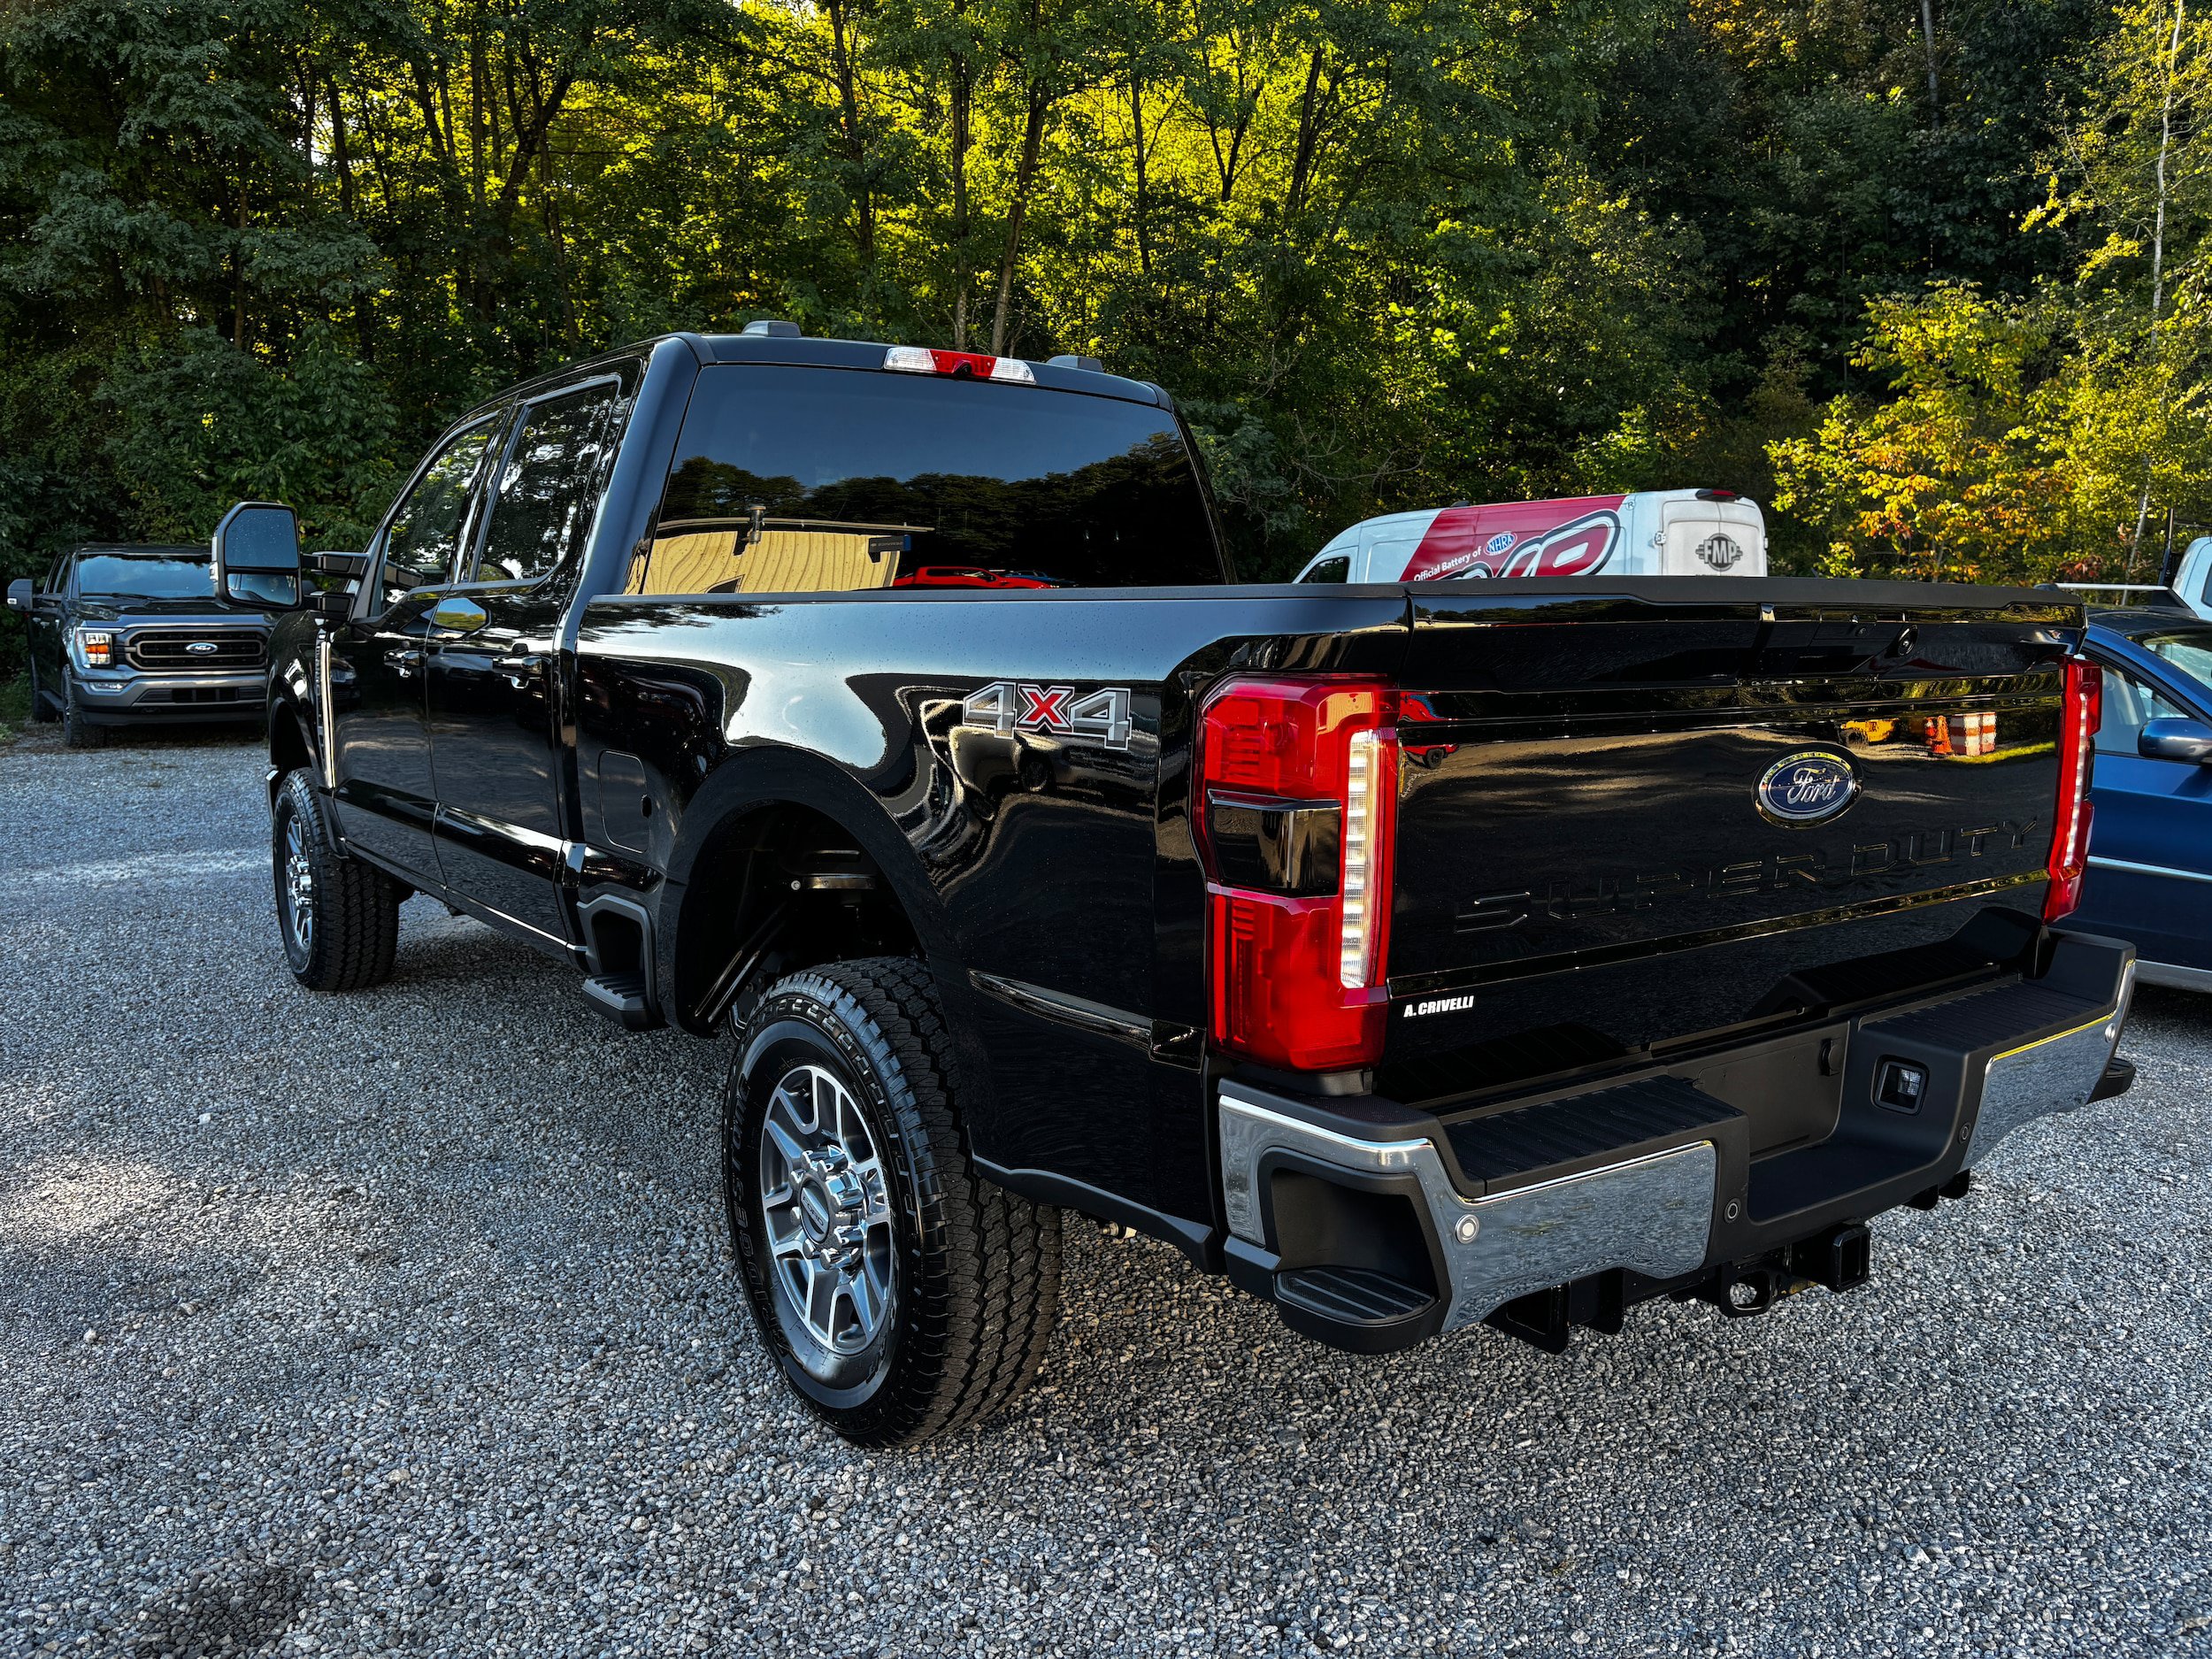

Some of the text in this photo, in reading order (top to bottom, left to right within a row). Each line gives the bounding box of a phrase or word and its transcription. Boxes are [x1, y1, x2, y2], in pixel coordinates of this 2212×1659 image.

[1486, 532, 1516, 553] NHRA
[1703, 539, 1737, 564] FMP
[1413, 545, 1483, 582] Official Battery of
[1786, 767, 1839, 804] Ford
[1455, 816, 2038, 934] SUPER DUTY
[1402, 995, 1475, 1018] A. CRIVELLI
[803, 1195, 825, 1227] FORD
